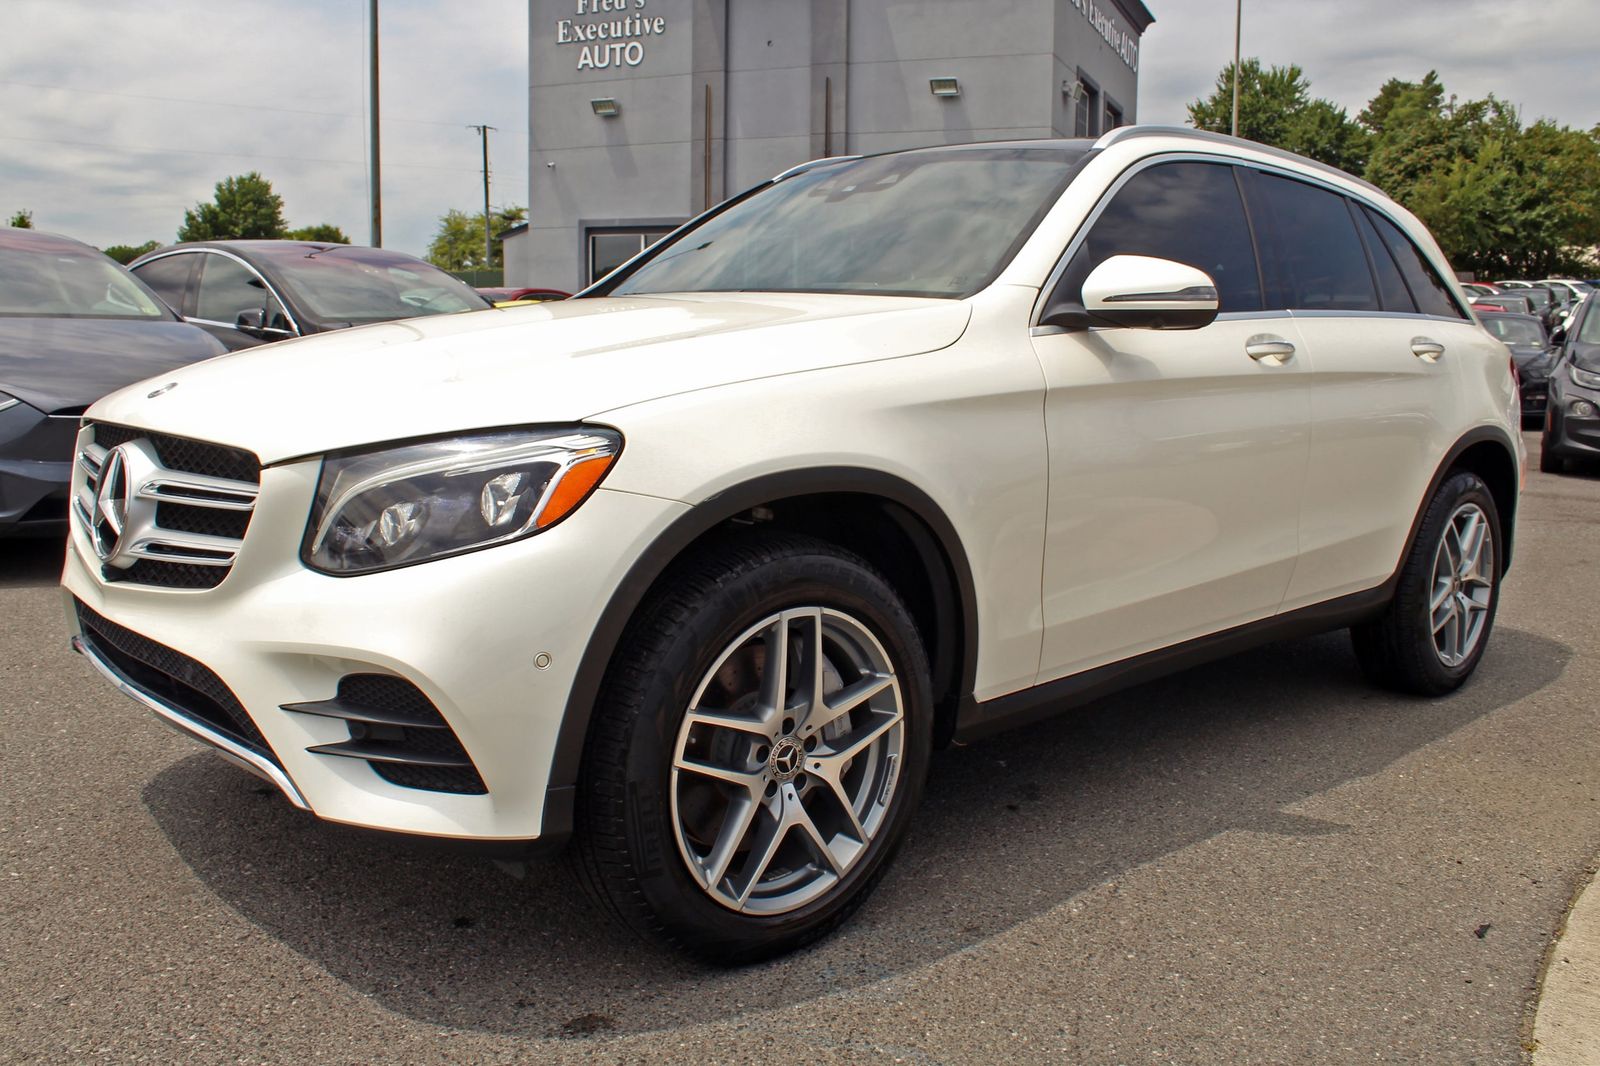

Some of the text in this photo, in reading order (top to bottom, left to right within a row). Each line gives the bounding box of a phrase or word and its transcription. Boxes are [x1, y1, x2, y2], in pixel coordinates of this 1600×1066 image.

[576, 0, 645, 14] Fres
[556, 13, 665, 44] Executive
[577, 41, 645, 70] AUTO
[1120, 31, 1138, 73] AUTO
